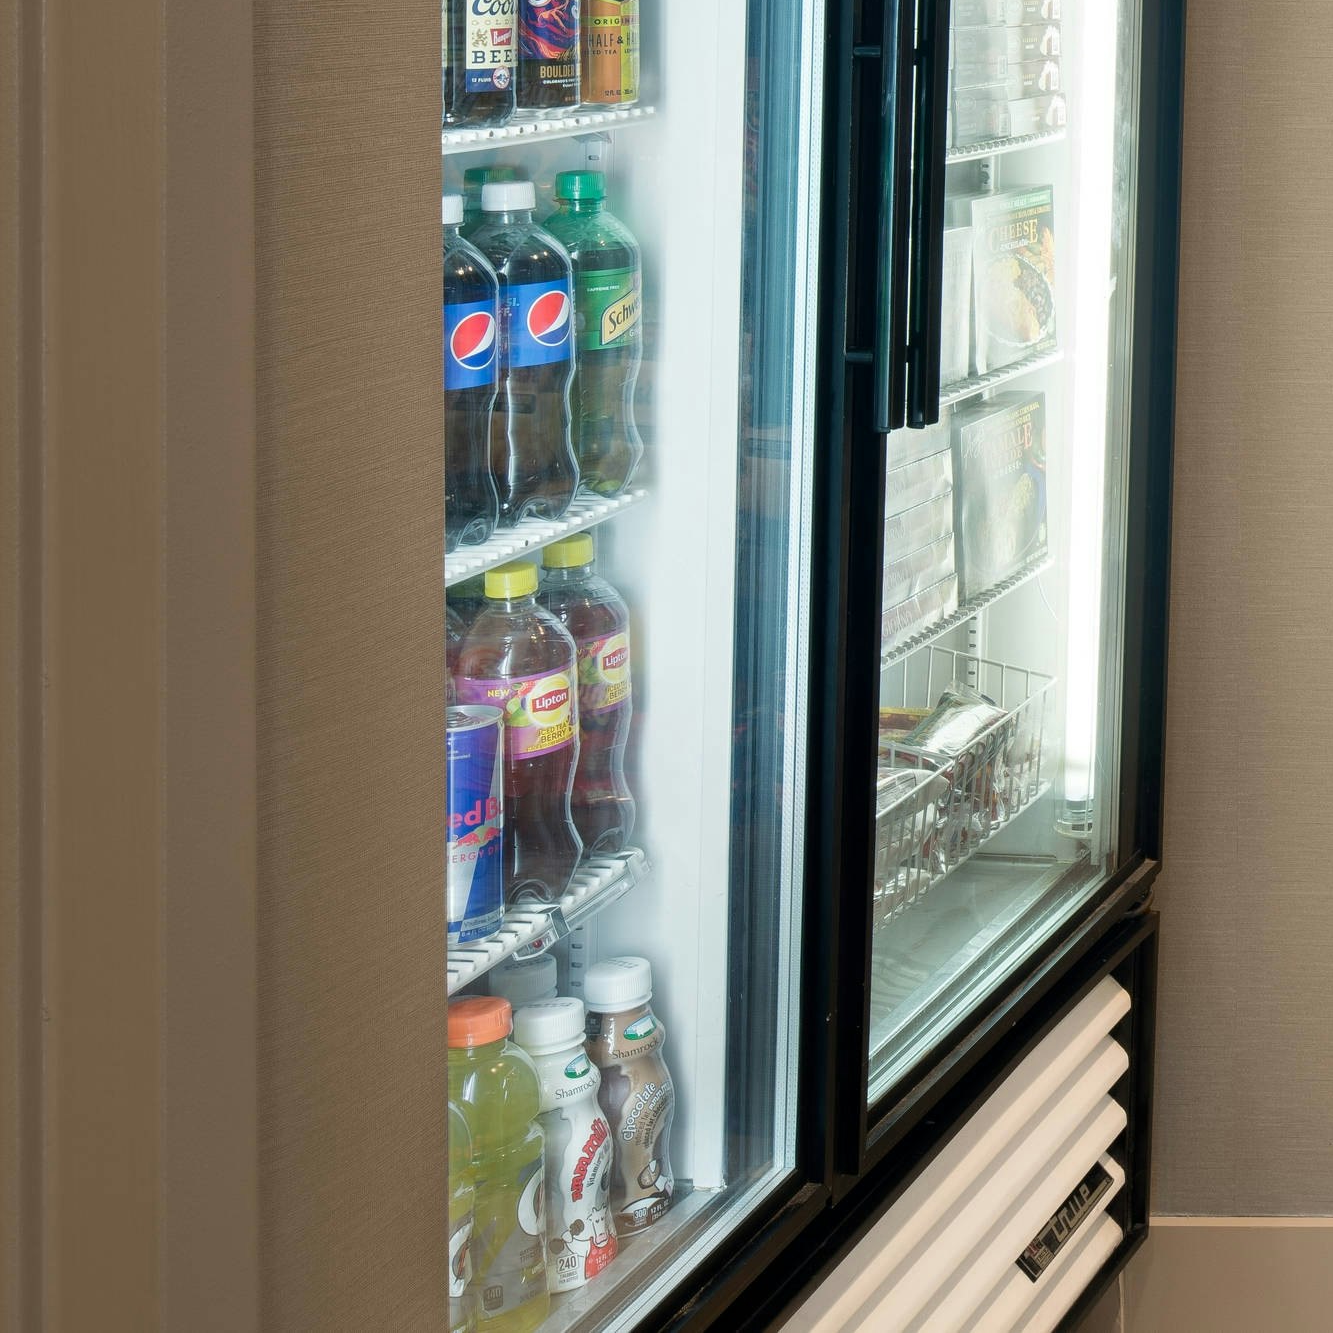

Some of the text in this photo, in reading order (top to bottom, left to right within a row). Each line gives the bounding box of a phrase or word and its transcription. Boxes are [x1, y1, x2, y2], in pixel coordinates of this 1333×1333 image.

[471, 49, 514, 64] BEE
[487, 689, 510, 698] NEW
[535, 690, 567, 709] Lipton
[446, 798, 482, 827] ed
[558, 1255, 577, 1272] 240
